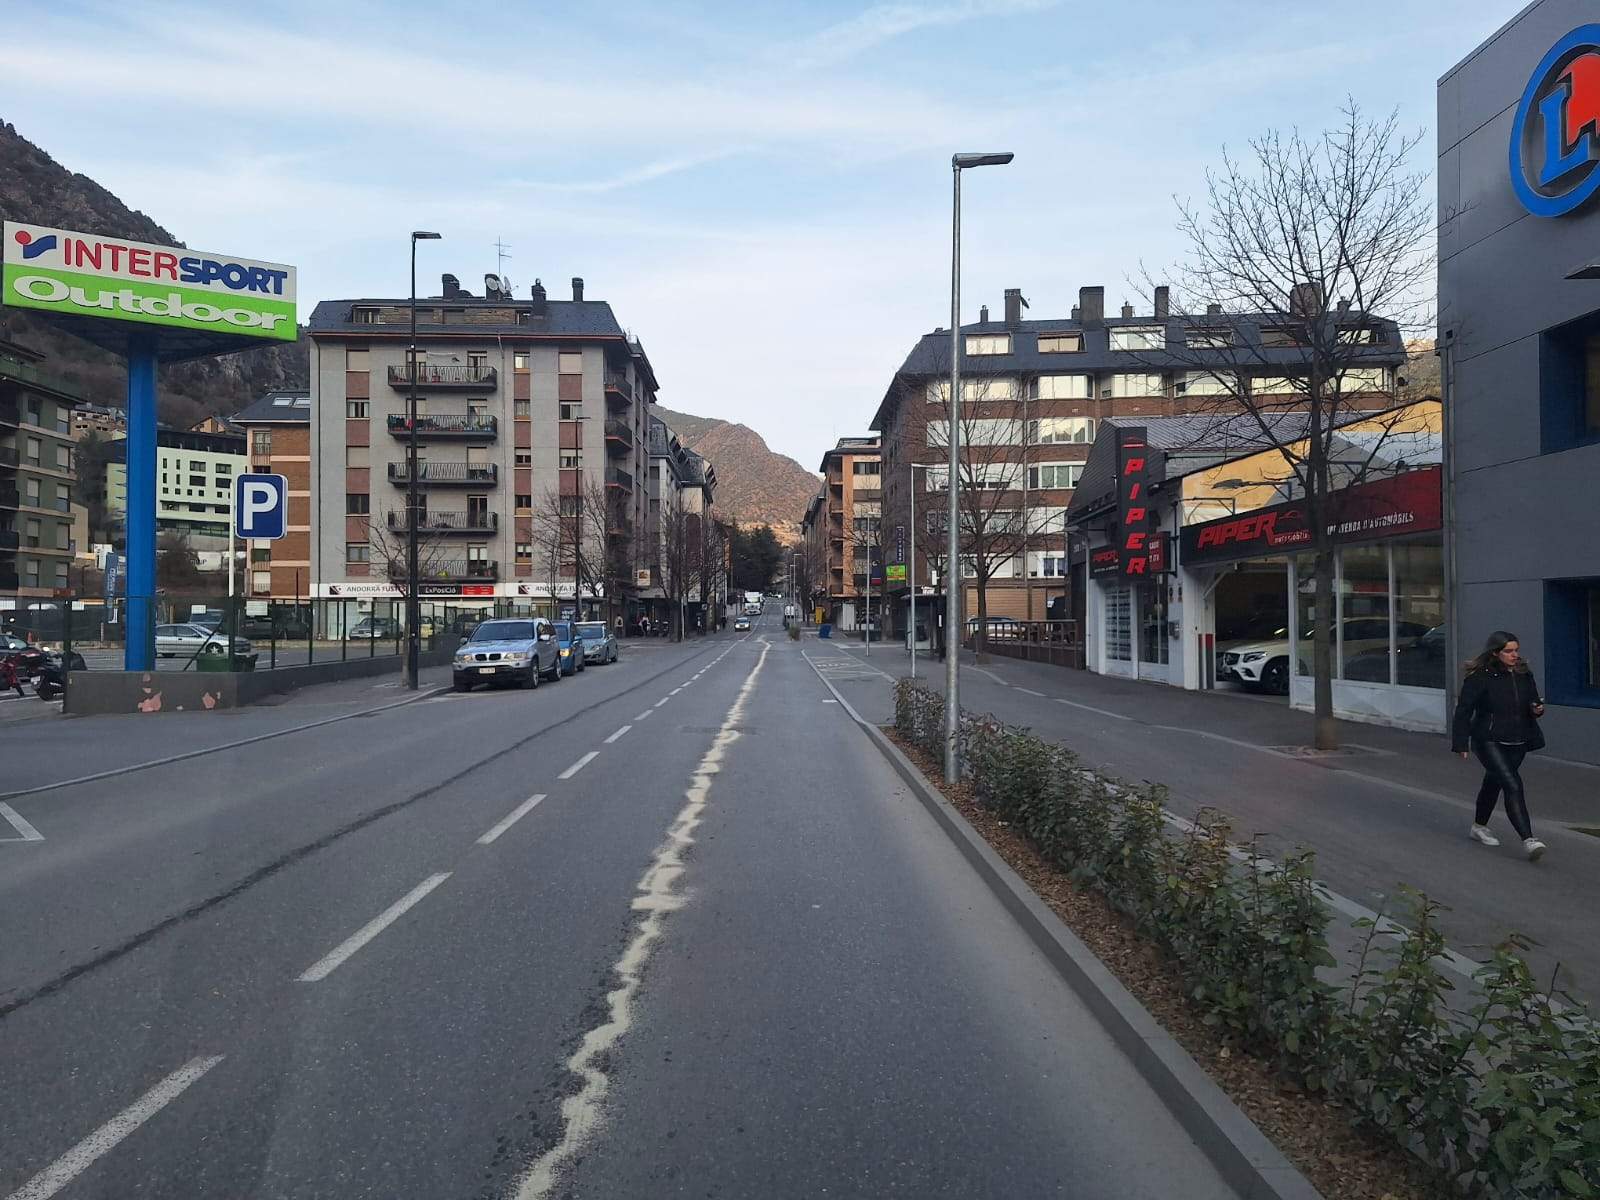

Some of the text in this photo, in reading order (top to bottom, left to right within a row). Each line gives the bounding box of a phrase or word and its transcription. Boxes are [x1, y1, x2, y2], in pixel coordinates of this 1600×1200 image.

[64, 236, 288, 296] INTERSPORT
[13, 275, 288, 330] Outdoor
[242, 481, 278, 530] P
[1124, 458, 1147, 574] PIPER
[1197, 511, 1278, 549] PIPER
[346, 584, 407, 593] ANDORRA FUSTS
